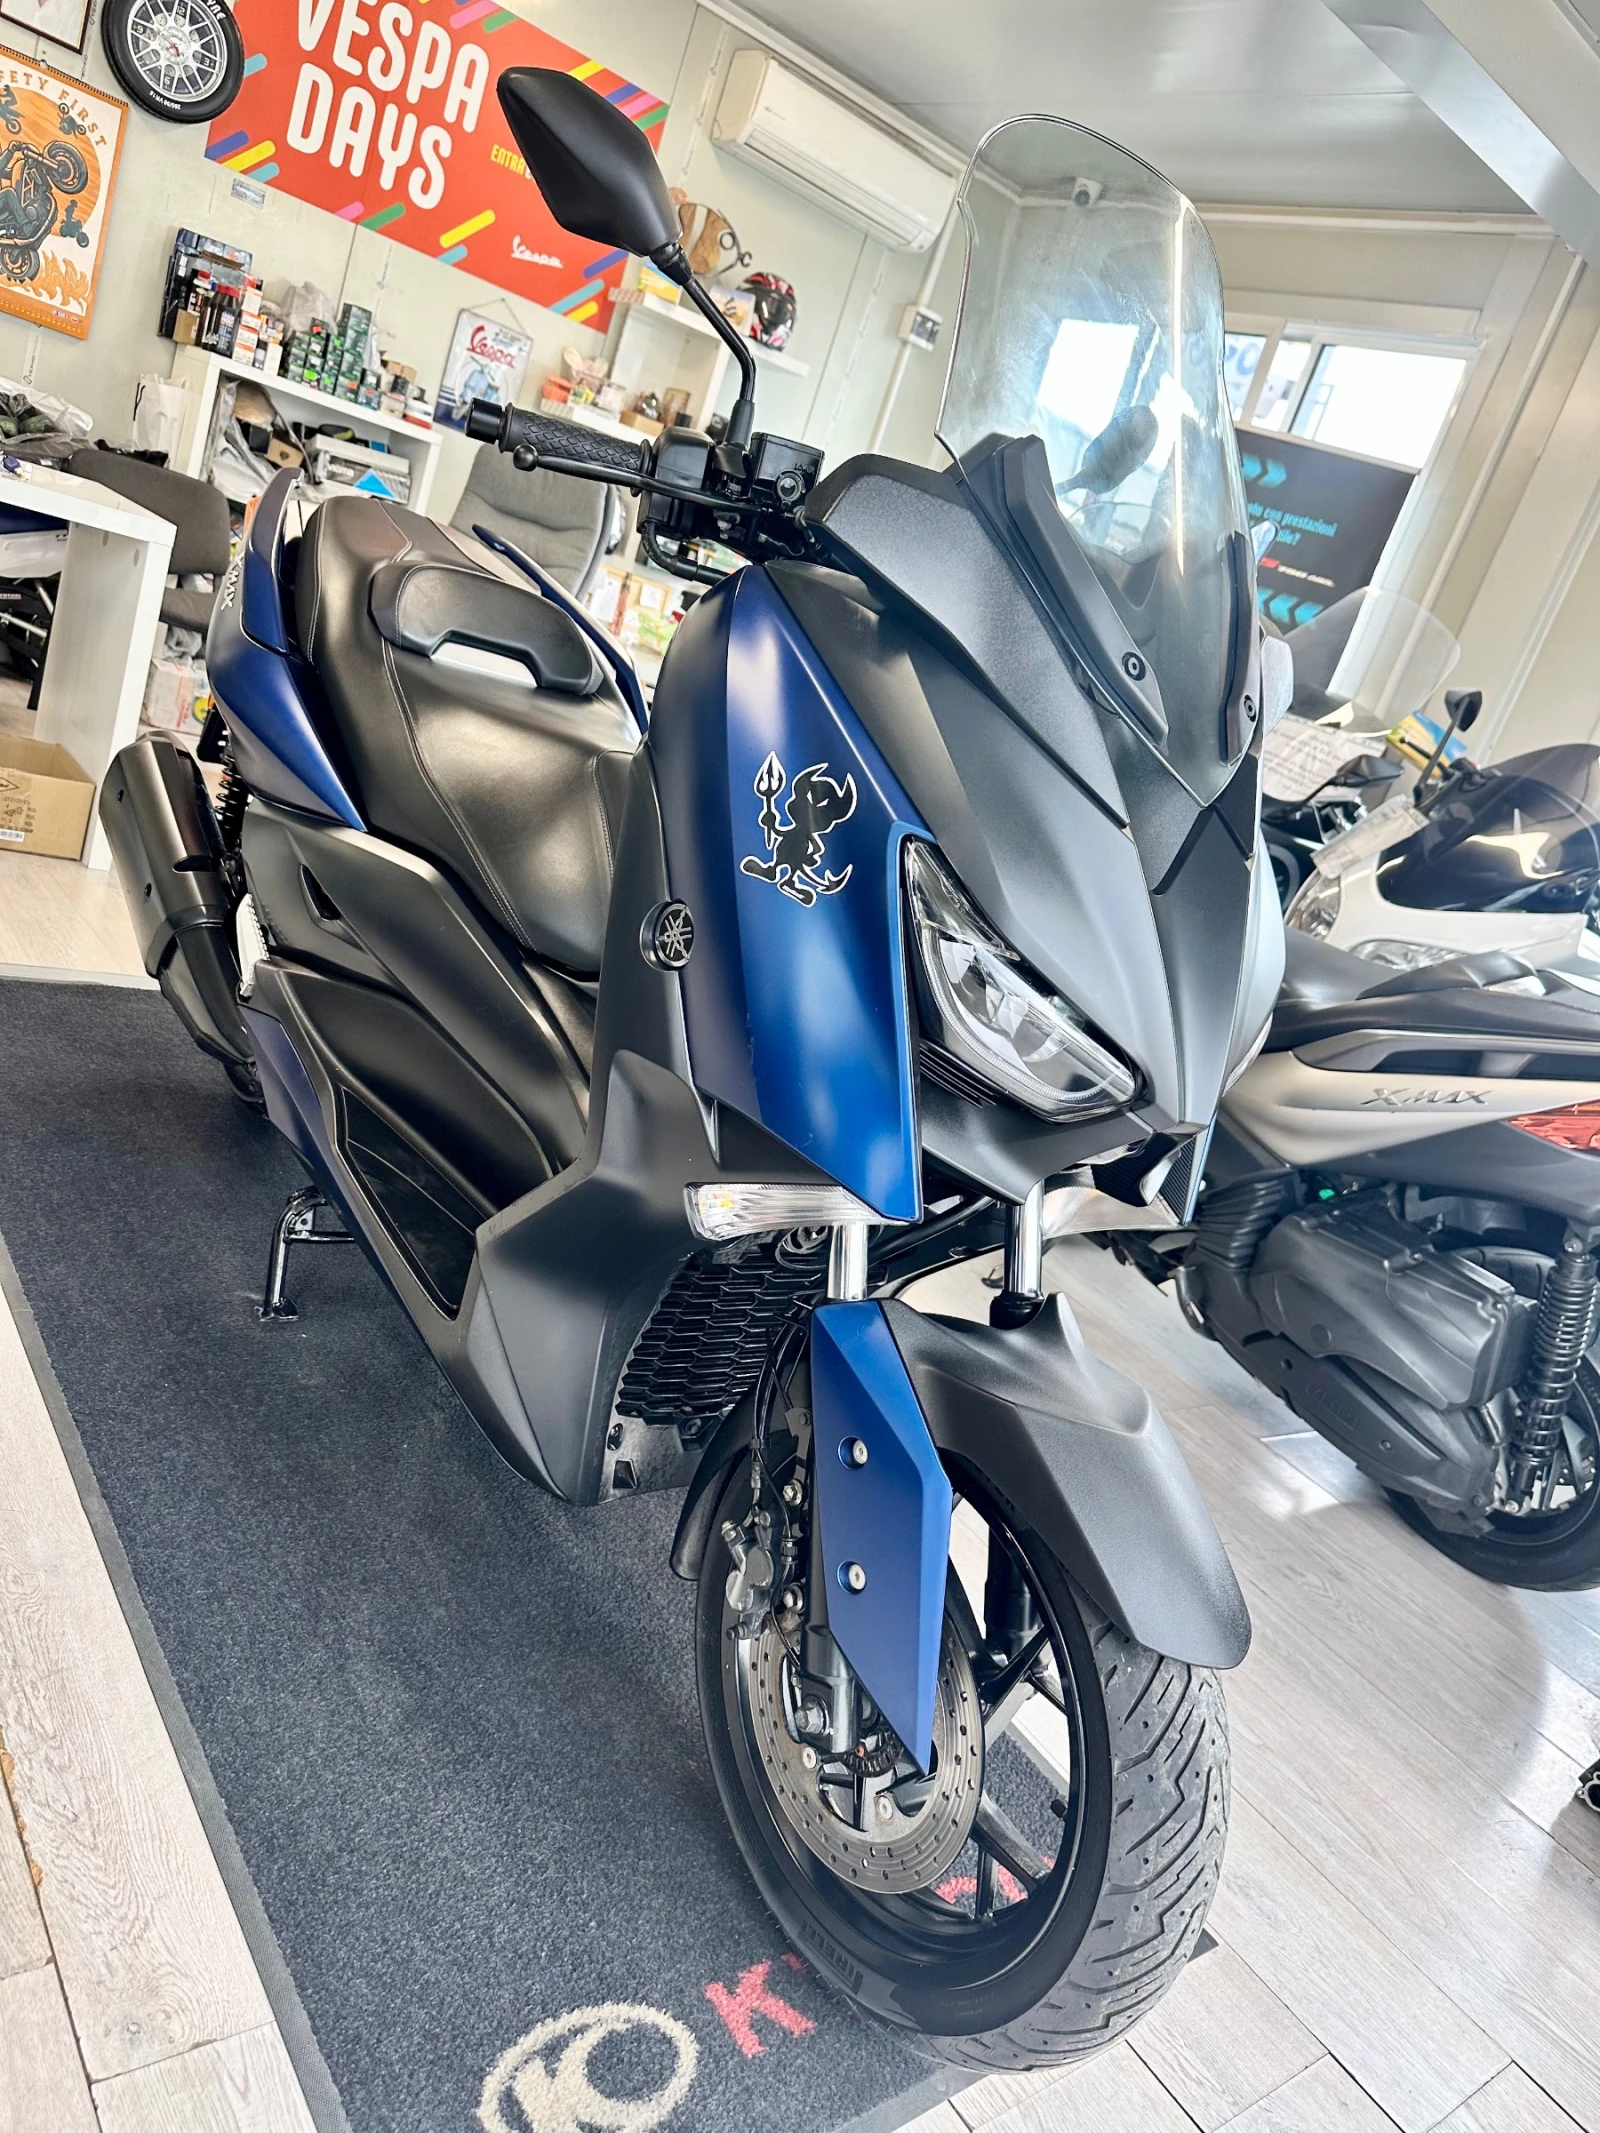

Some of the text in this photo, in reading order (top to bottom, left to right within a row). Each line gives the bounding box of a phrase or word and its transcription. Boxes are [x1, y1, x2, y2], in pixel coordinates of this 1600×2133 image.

[298, 0, 490, 133] VESPA
[58, 89, 108, 147] FIRST
[286, 62, 453, 210] DAYS
[510, 235, 564, 269] Vespa
[466, 325, 517, 369] Vespa
[1281, 512, 1339, 538] prestazioni
[798, 1918, 865, 1996] PIRELLI
